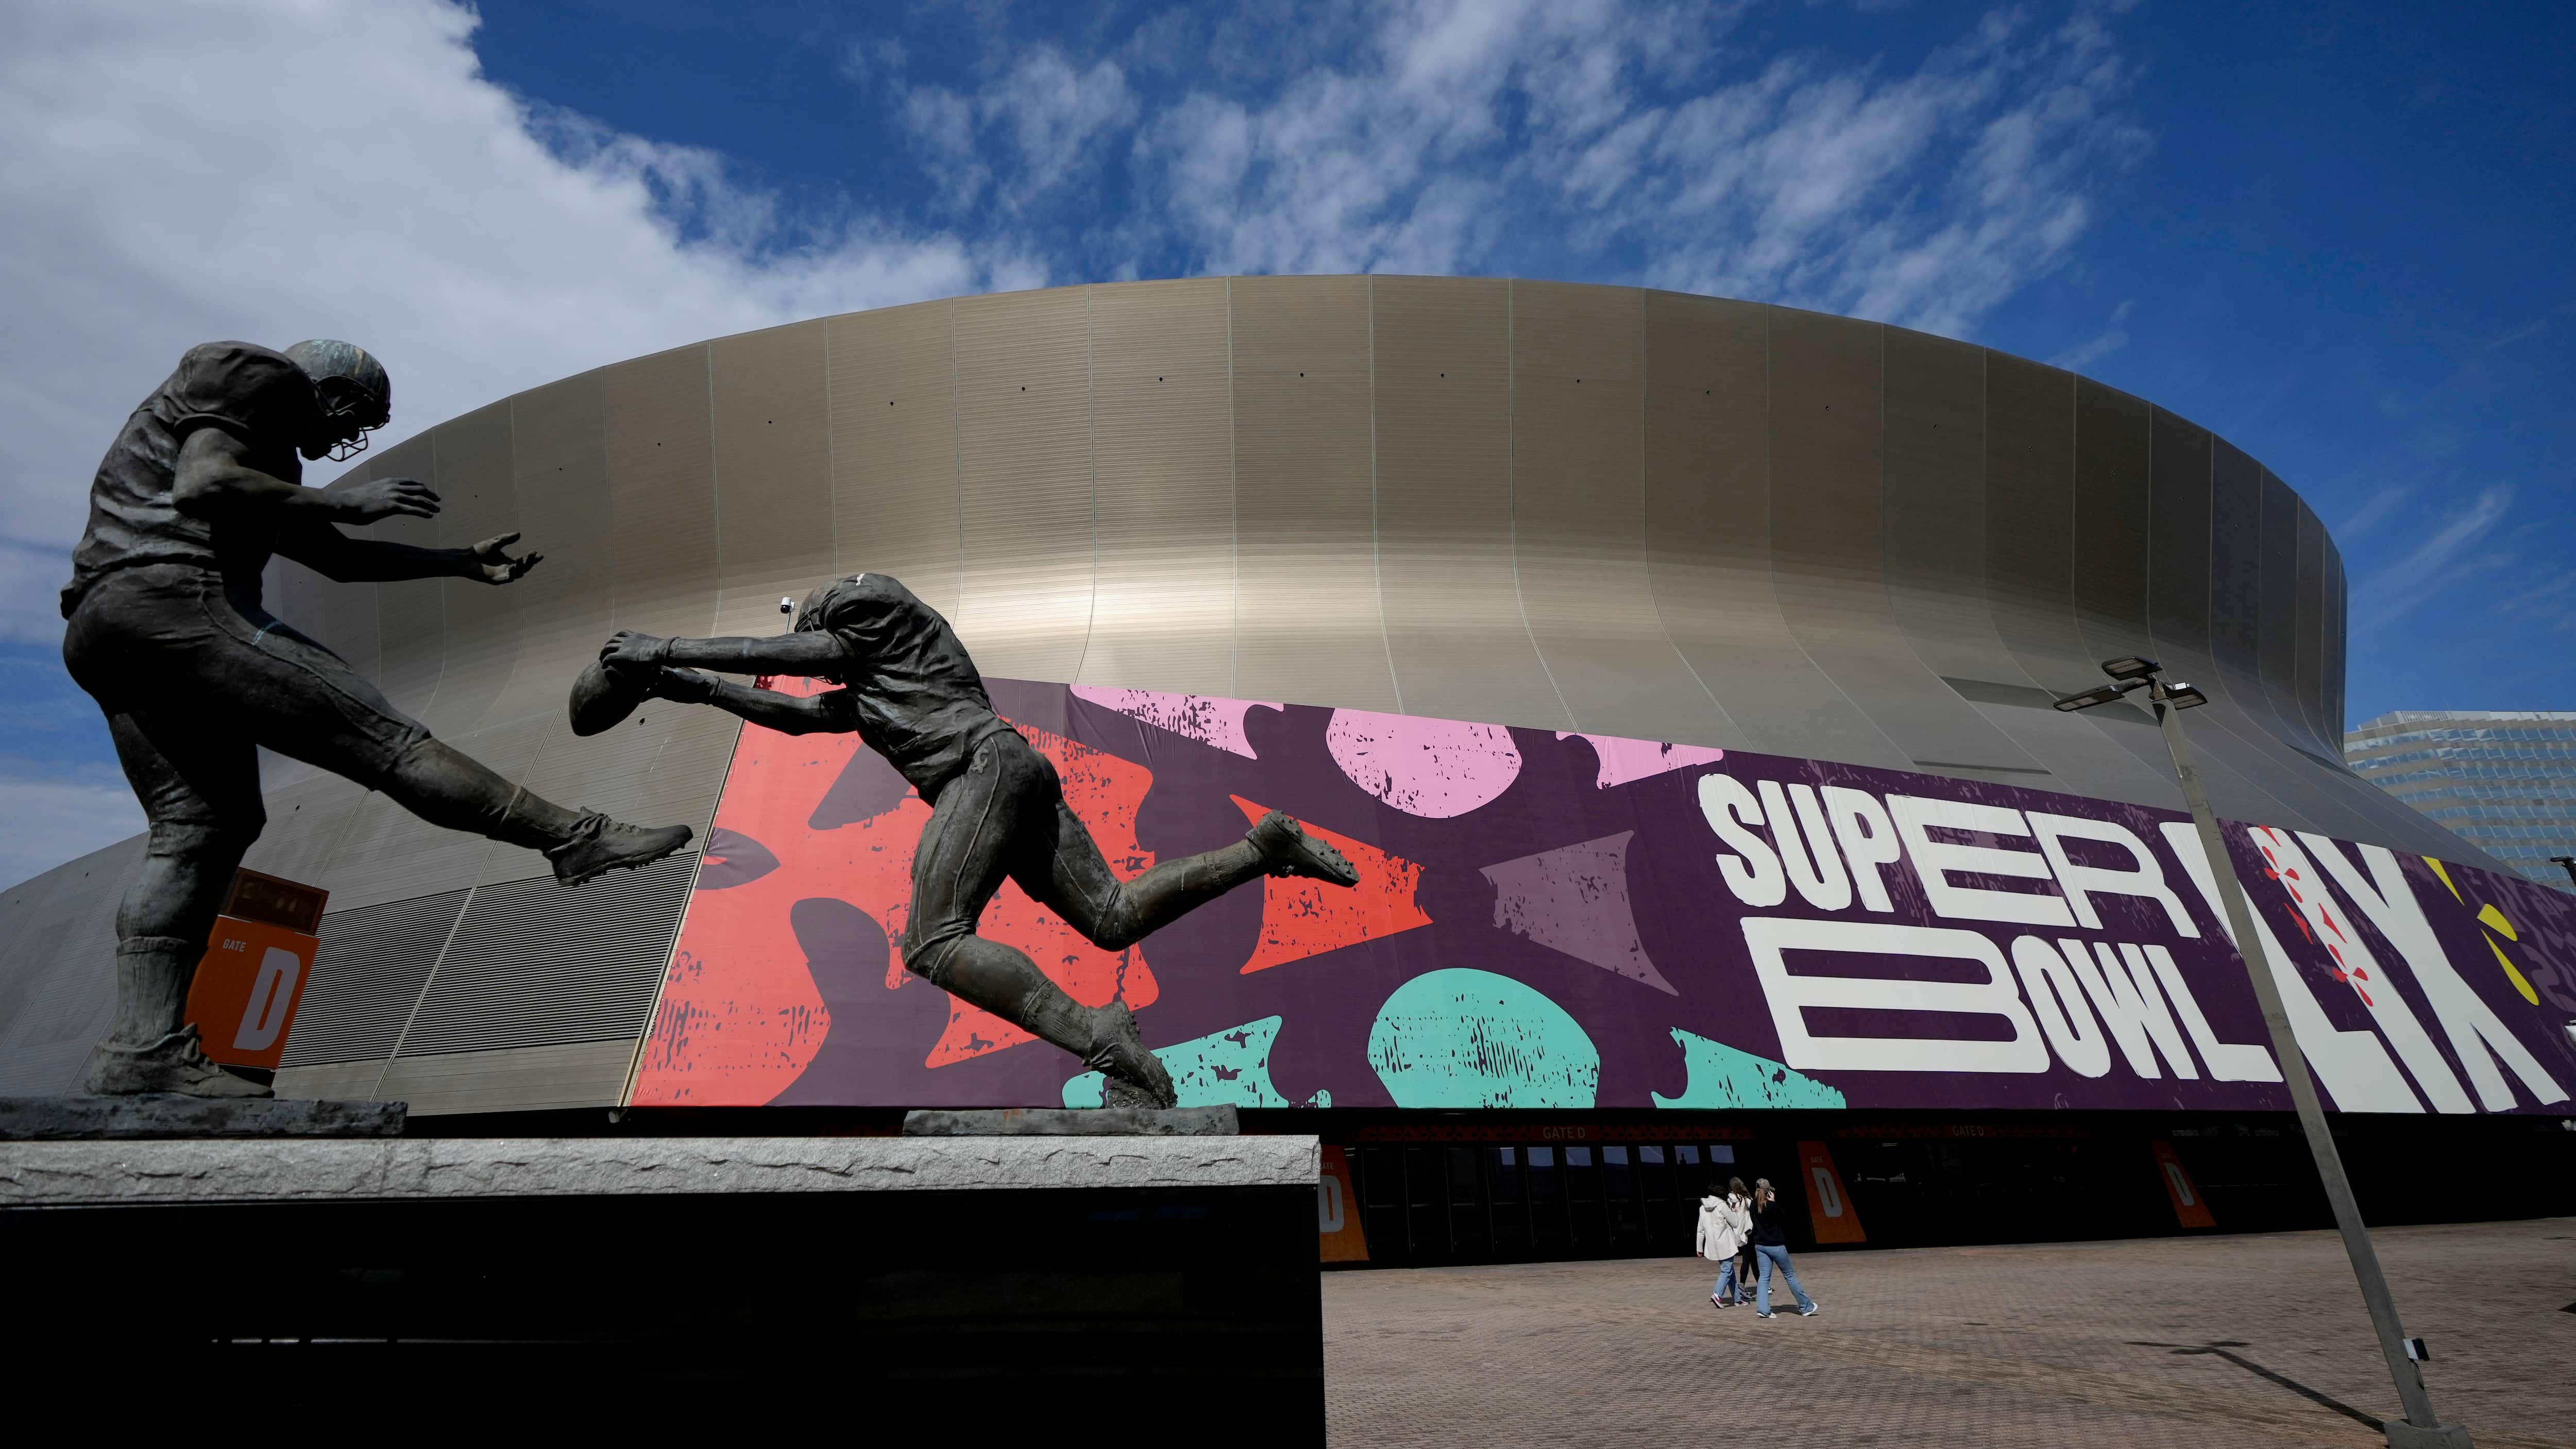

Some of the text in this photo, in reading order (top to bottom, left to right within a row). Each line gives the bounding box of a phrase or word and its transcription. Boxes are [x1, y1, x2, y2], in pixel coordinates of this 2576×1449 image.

[1698, 773, 2200, 938] SUPER
[223, 938, 247, 952] GATE
[2159, 822, 2570, 1114] LIX
[232, 947, 300, 1051] D
[1740, 917, 2283, 1083] BOWL
[1543, 1126, 1586, 1138] GATE D
[1953, 1125, 1976, 1137] GATE
[1317, 1175, 1344, 1233] D
[1811, 1167, 1842, 1217] D
[2164, 1162, 2195, 1206] D
